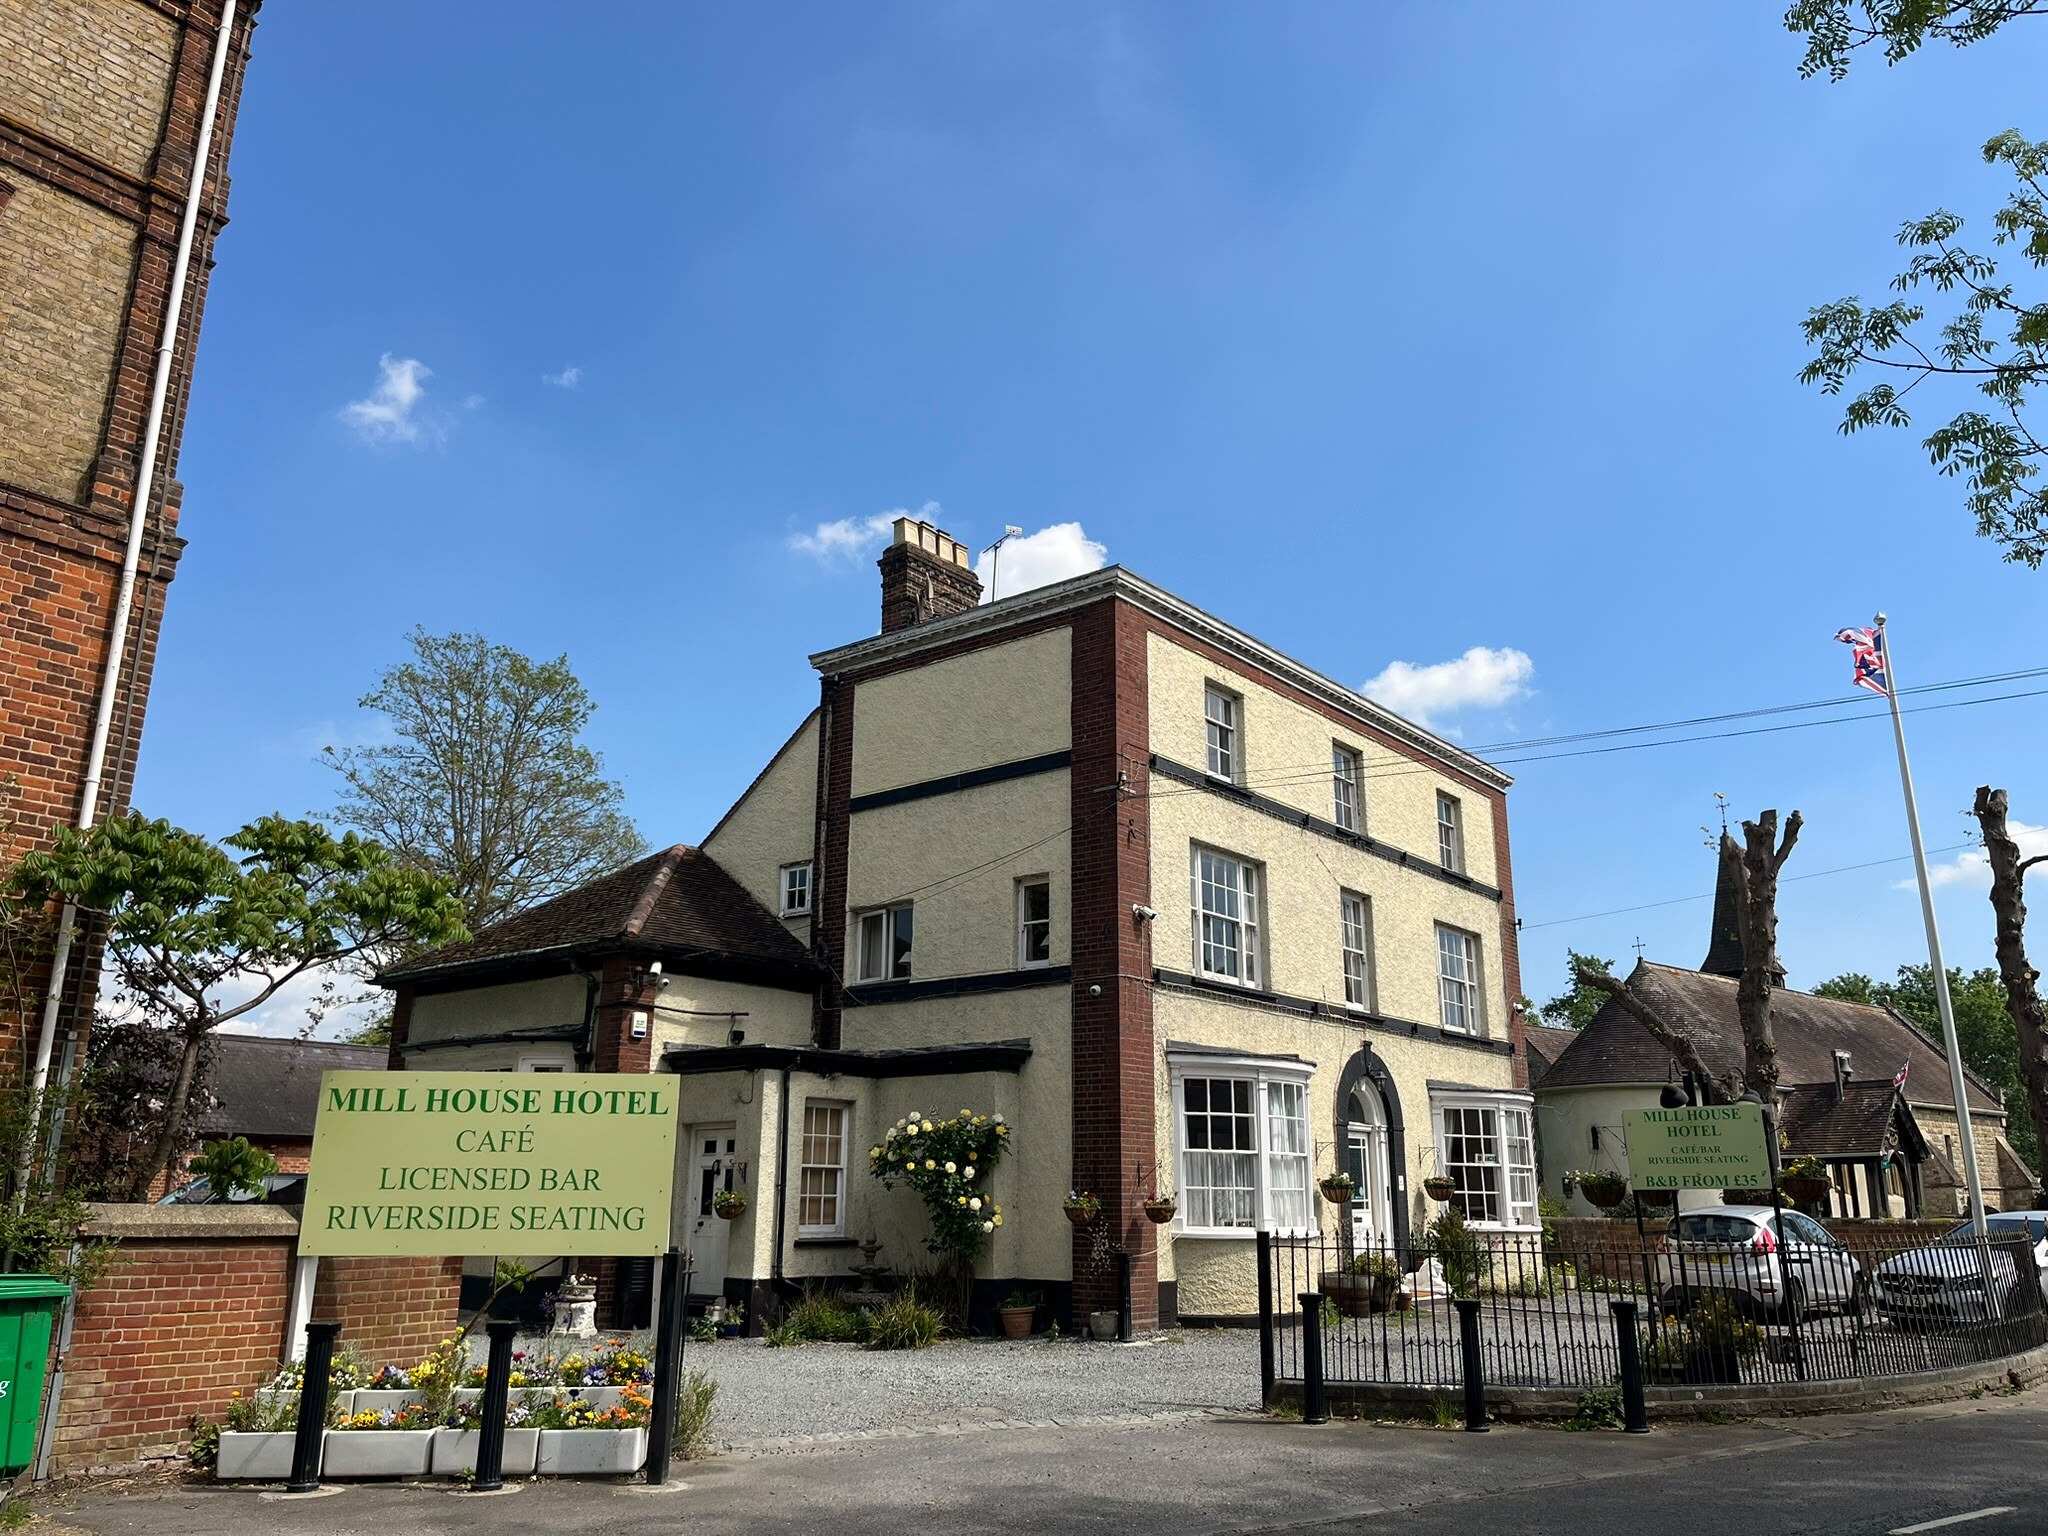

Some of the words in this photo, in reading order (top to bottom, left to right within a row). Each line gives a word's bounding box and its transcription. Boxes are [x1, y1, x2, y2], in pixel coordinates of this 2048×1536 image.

[327, 1087, 416, 1113] MILL
[424, 1088, 541, 1114] HOUSE
[551, 1089, 670, 1115] HOTEL
[1643, 1110, 1683, 1122] MILL
[1687, 1108, 1741, 1121] HOUSE
[456, 1124, 535, 1153] CAFÉ
[1667, 1125, 1722, 1137] HOTEL
[1648, 1156, 1701, 1165] RIVERSIDE
[1704, 1154, 1749, 1164] SEATING
[379, 1167, 531, 1191] LICENSED
[540, 1168, 601, 1191] BAR
[1646, 1175, 1678, 1187] B&B
[1682, 1175, 1729, 1187] FROM
[1734, 1174, 1758, 1186] £35
[325, 1205, 500, 1231] RIVERSIDE
[509, 1205, 646, 1232] SEATING
